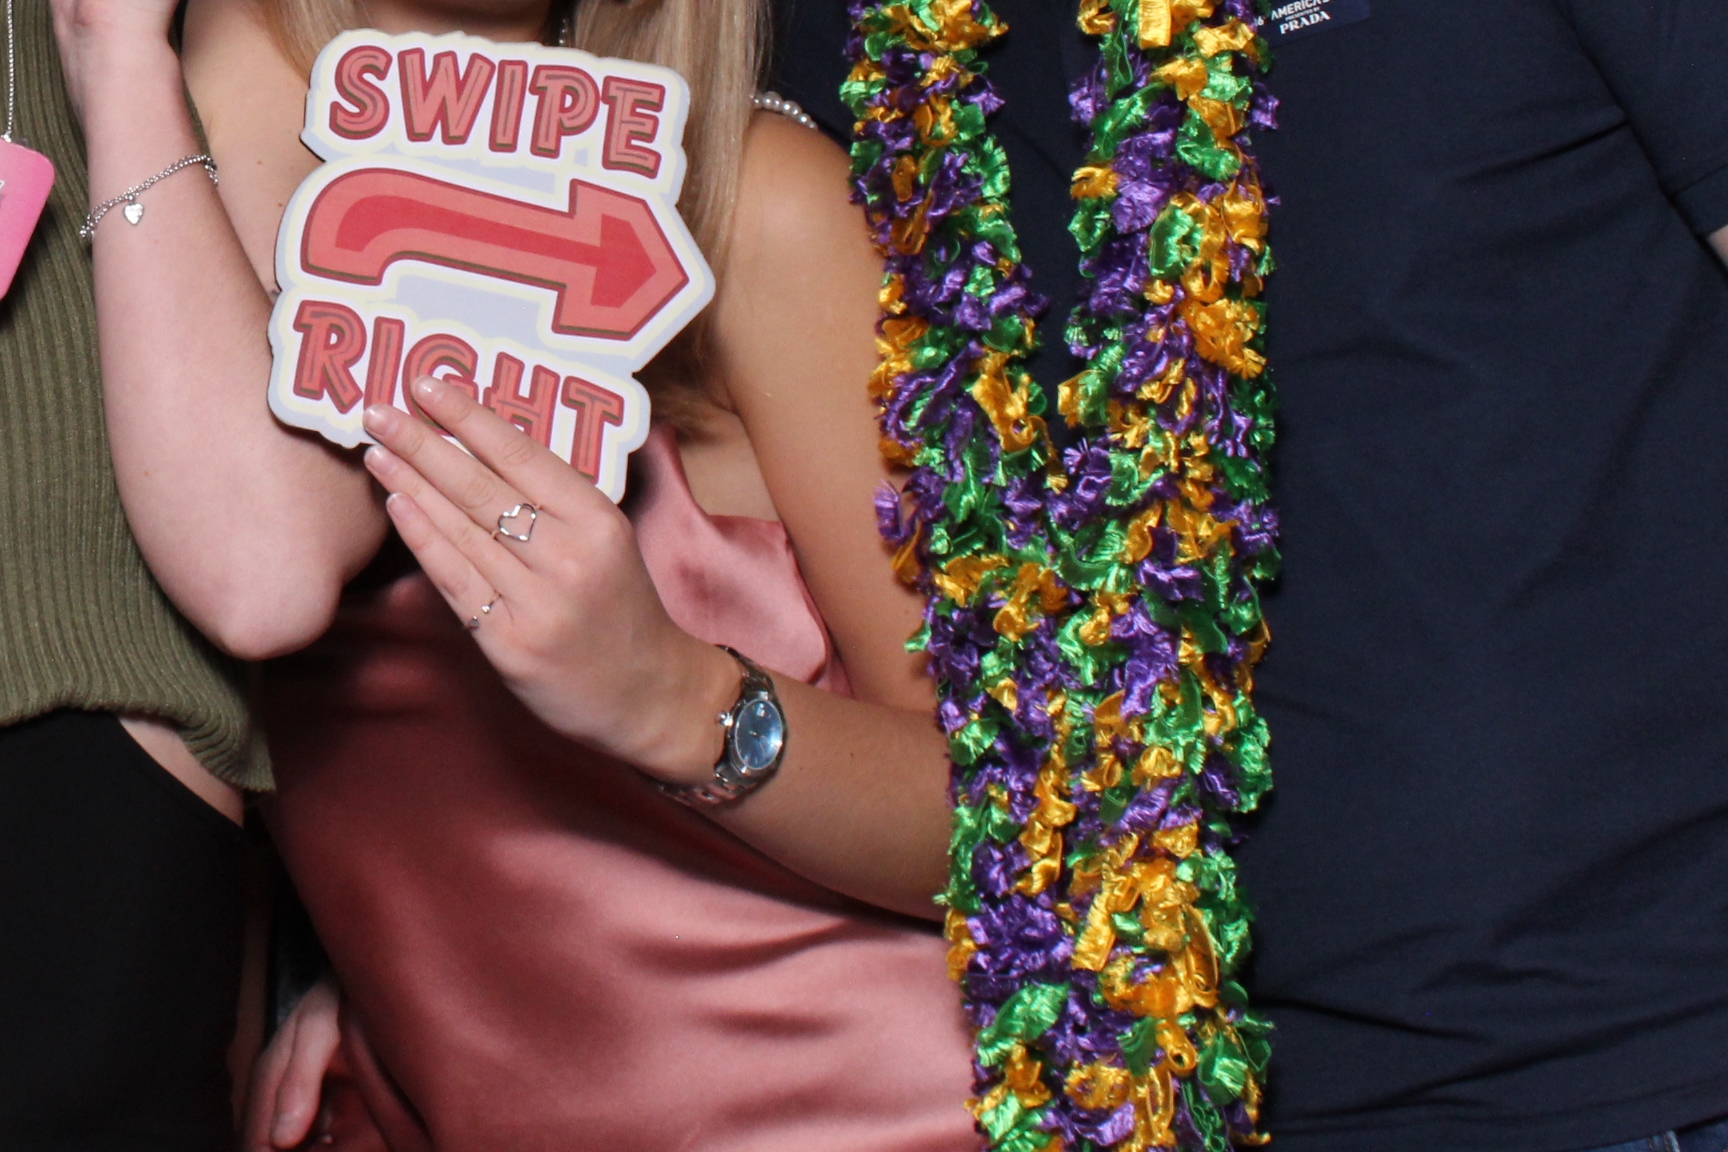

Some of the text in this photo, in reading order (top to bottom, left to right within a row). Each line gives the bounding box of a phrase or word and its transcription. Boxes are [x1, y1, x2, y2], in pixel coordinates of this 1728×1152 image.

[1279, 11, 1331, 35] PRADA
[329, 45, 666, 179] SWIPE
[293, 300, 624, 484] RIGHT
